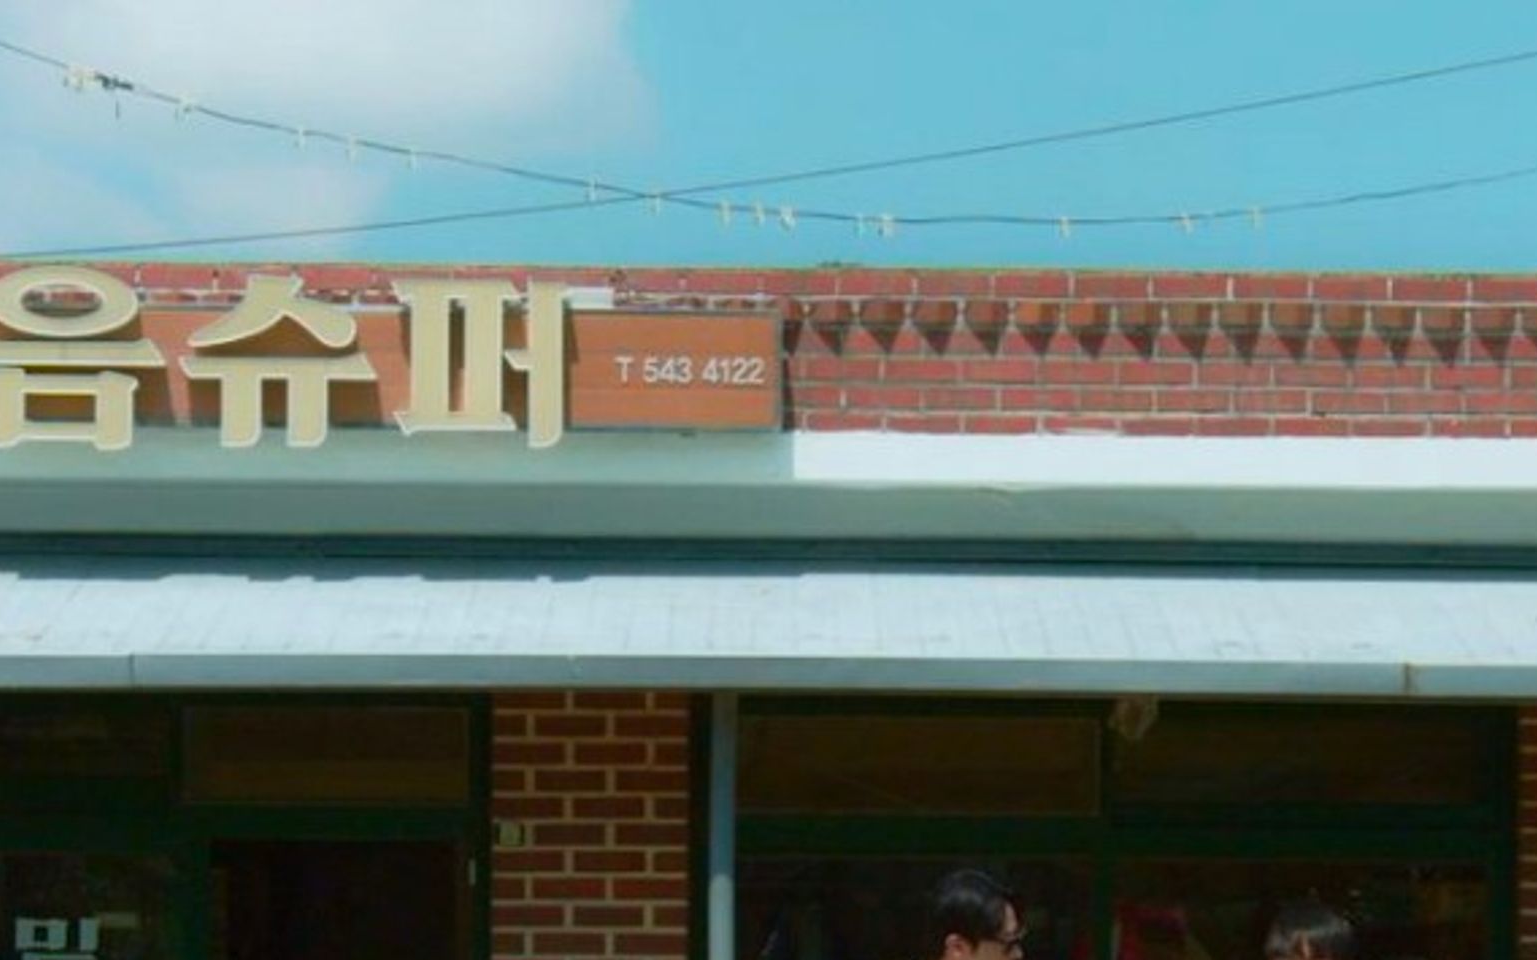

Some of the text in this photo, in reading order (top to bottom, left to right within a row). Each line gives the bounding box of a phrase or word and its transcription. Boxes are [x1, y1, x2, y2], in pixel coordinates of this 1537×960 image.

[615, 355, 764, 384] T 543 4122
